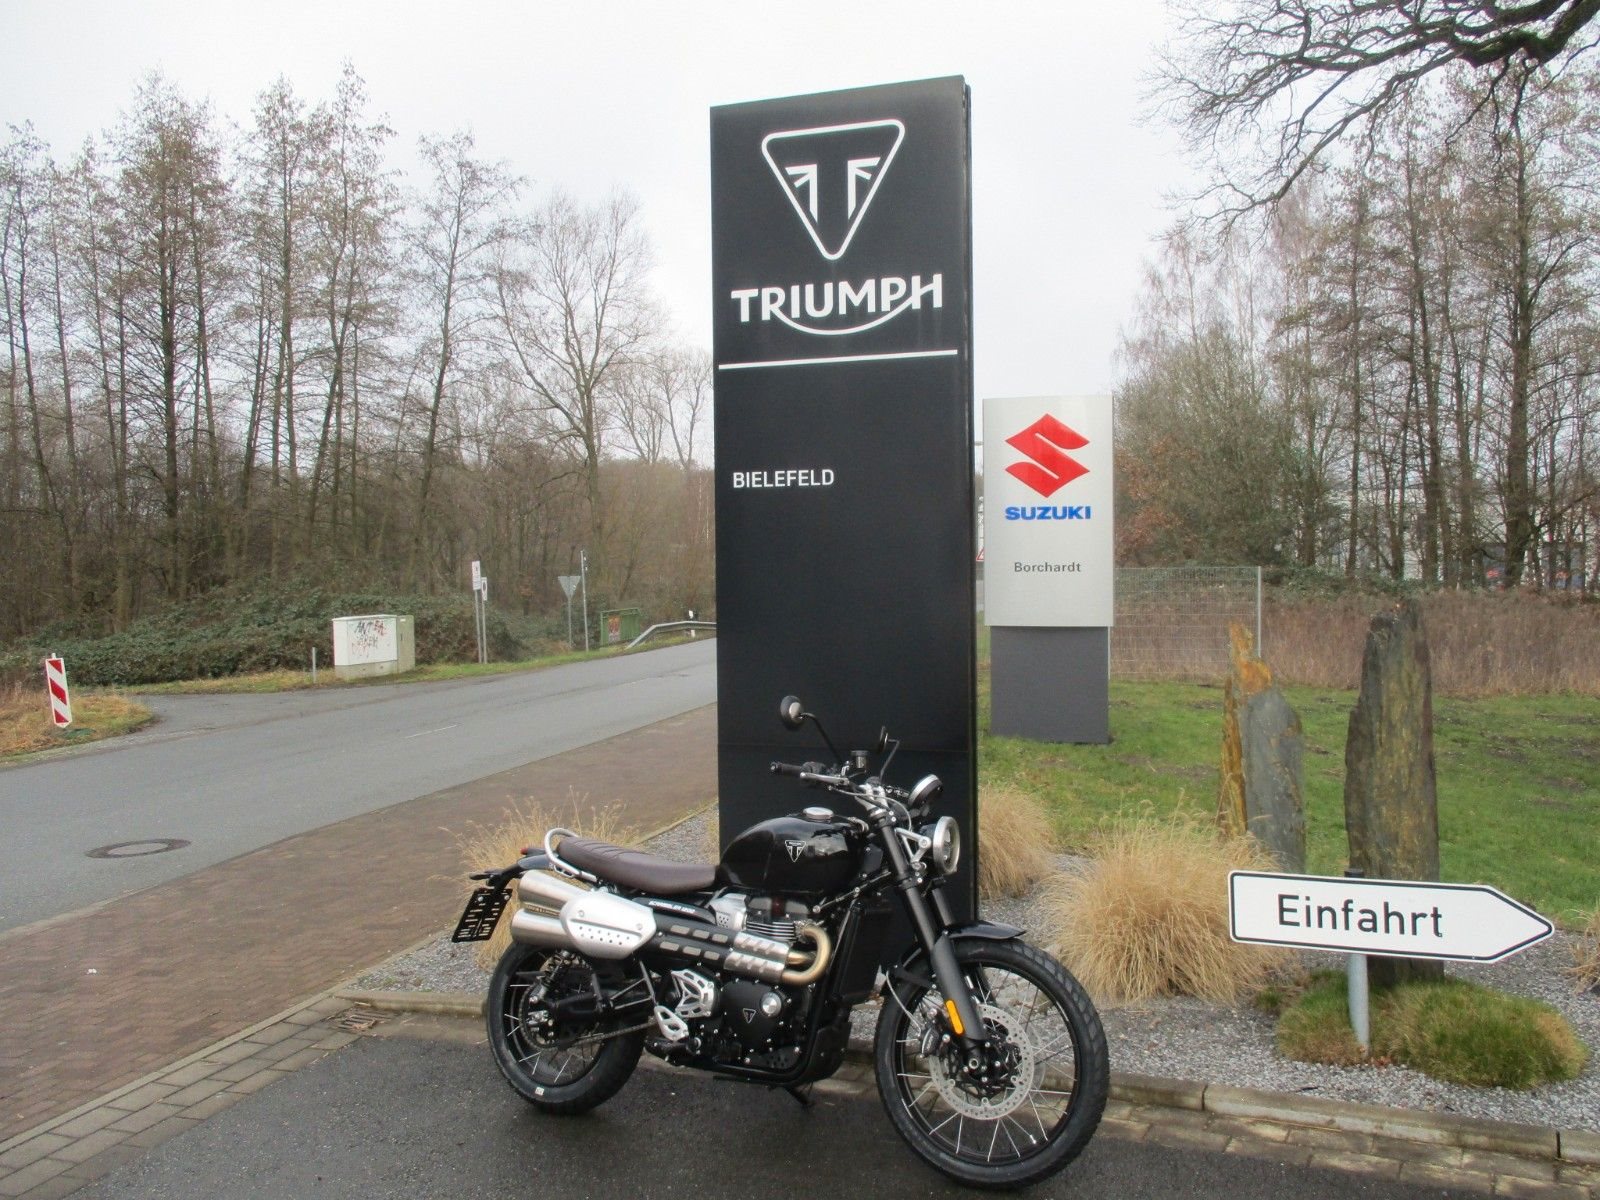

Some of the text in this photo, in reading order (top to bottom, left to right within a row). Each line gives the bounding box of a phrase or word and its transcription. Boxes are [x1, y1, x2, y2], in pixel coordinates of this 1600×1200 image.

[730, 273, 943, 335] TRIUMPH
[733, 469, 835, 488] BIELEFELD
[1005, 506, 1091, 520] SUZUKI
[1014, 562, 1082, 573] Borchardt
[1278, 893, 1443, 938] Einfahrt
